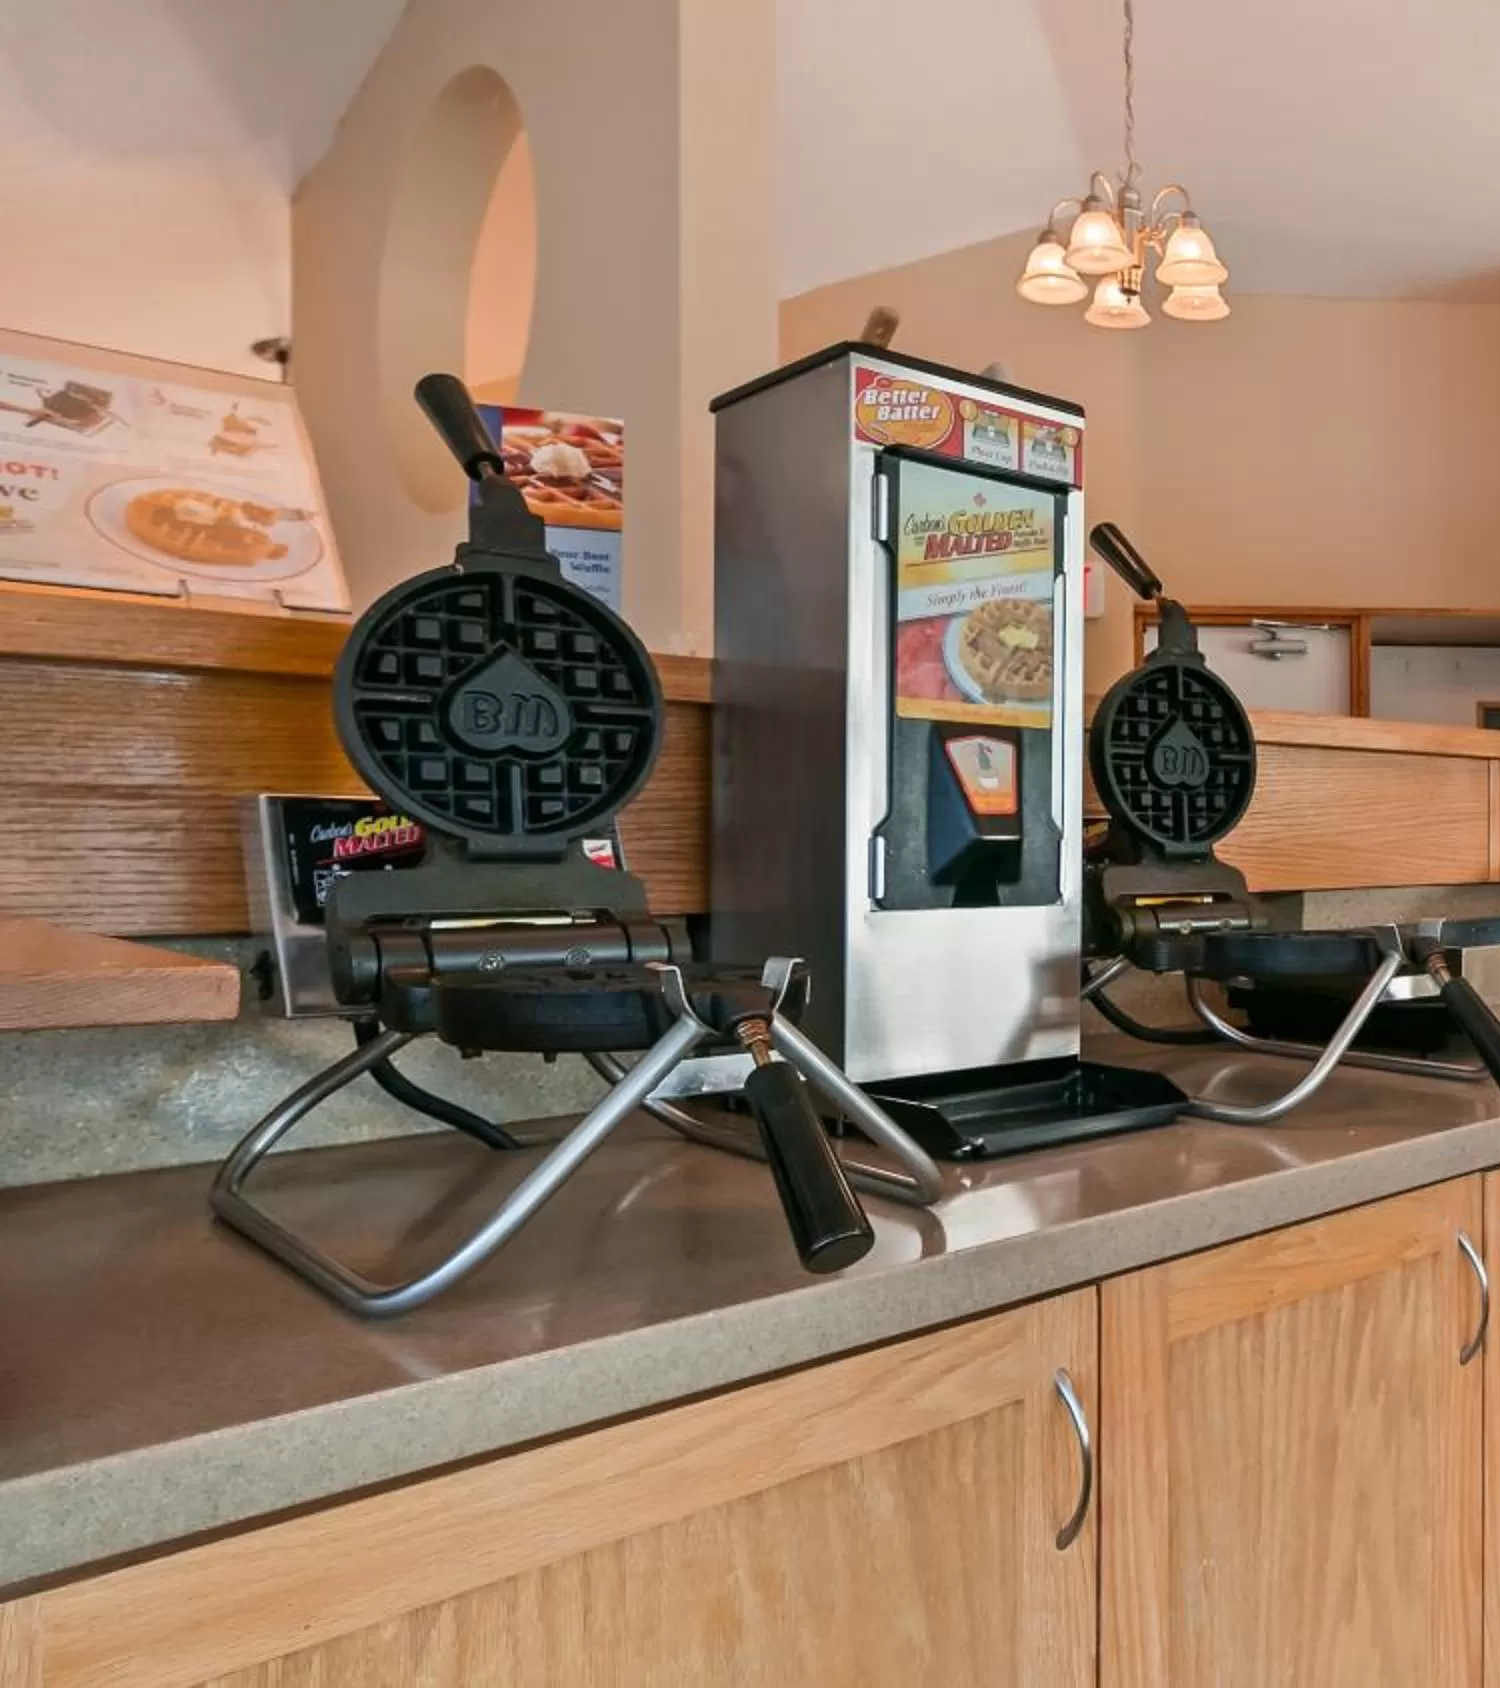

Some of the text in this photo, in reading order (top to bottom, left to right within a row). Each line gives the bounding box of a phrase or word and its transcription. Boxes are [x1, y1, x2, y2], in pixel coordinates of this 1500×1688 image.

[863, 389, 929, 405] Better
[876, 405, 940, 421] Batter
[947, 508, 1034, 534] GOLDEN
[924, 529, 1013, 561] MALTED
[969, 585, 987, 601] the
[333, 826, 420, 858] MALTED
